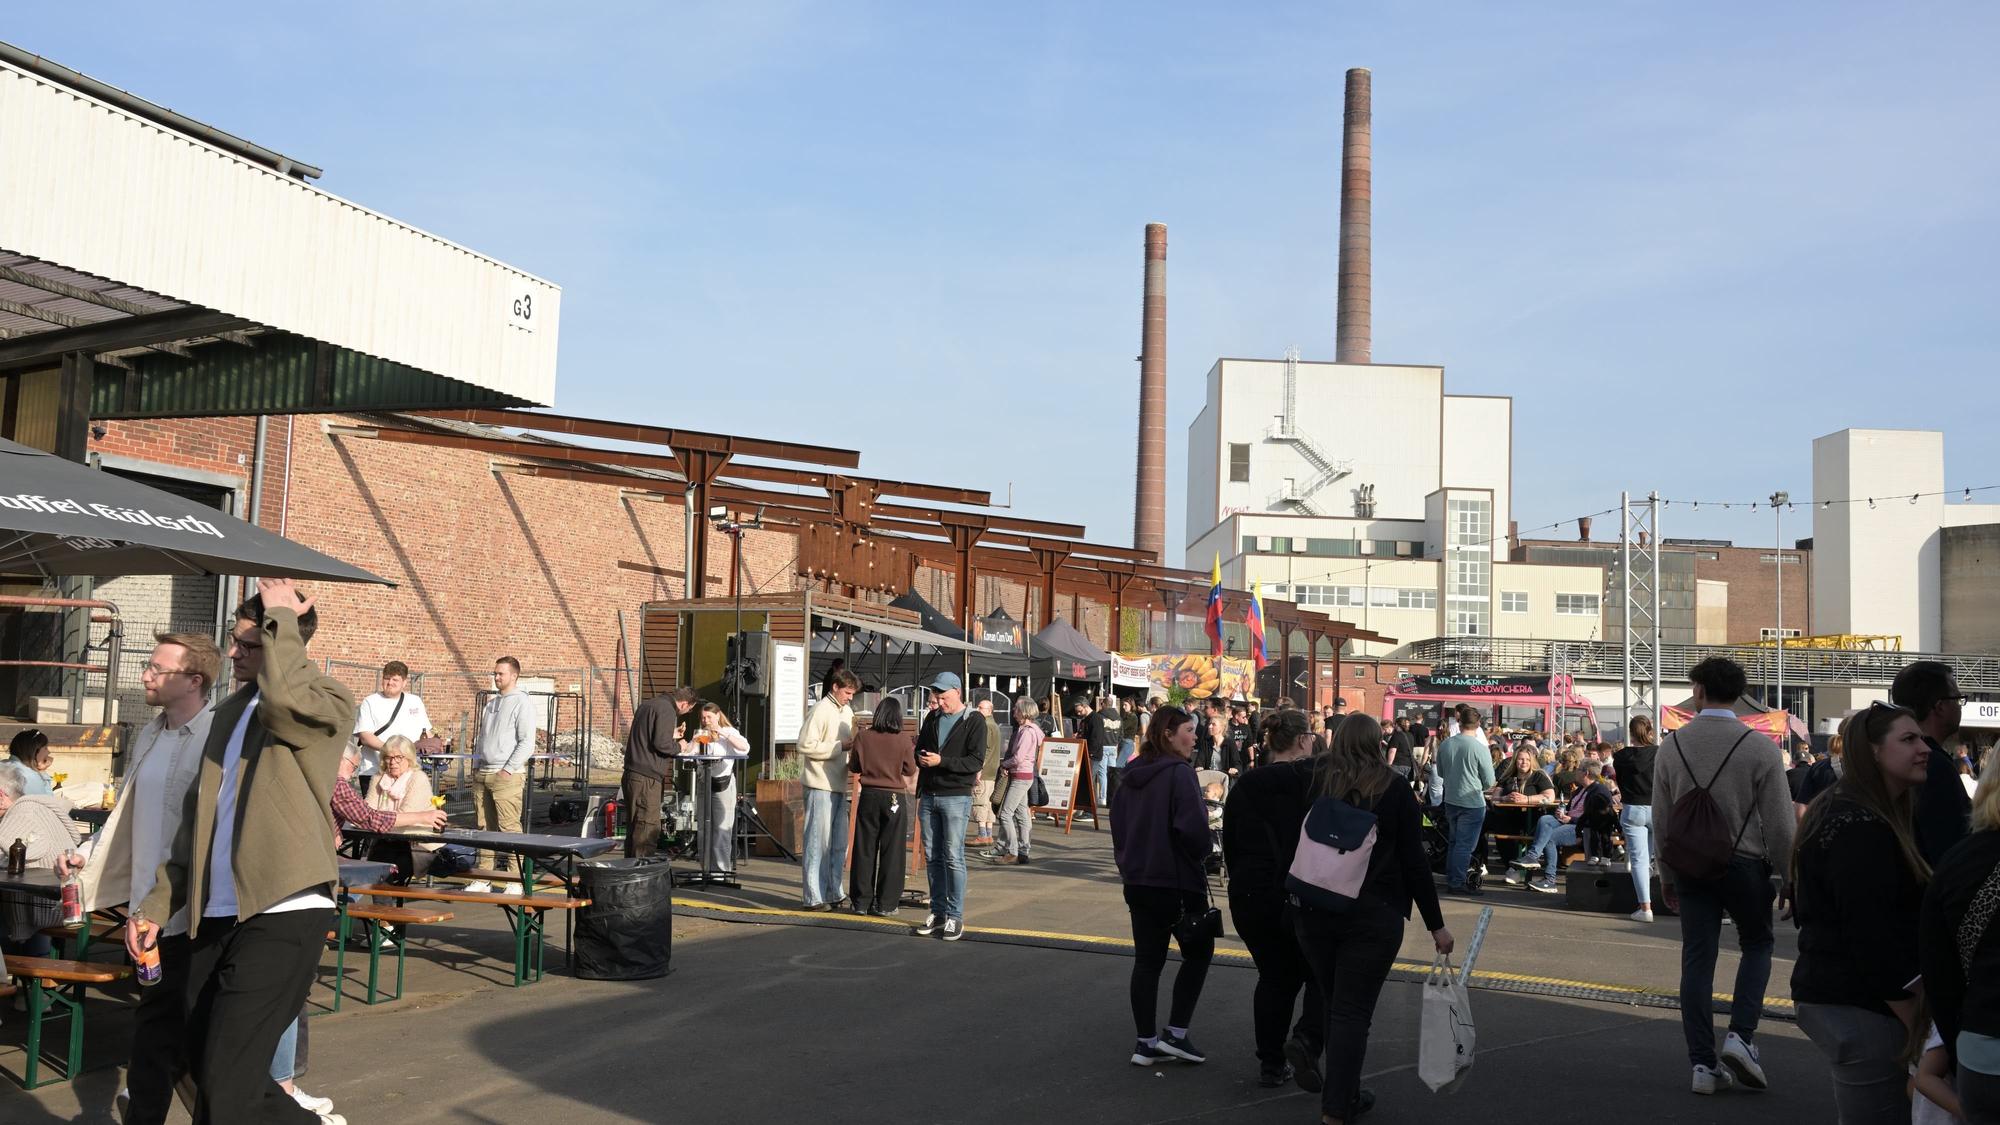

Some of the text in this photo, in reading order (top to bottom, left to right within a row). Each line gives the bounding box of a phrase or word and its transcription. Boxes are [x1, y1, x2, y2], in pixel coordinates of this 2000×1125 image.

[513, 294, 532, 320] G3
[1430, 677, 1454, 685] LATIN
[1470, 685, 1534, 693] SANDWICHERIA
